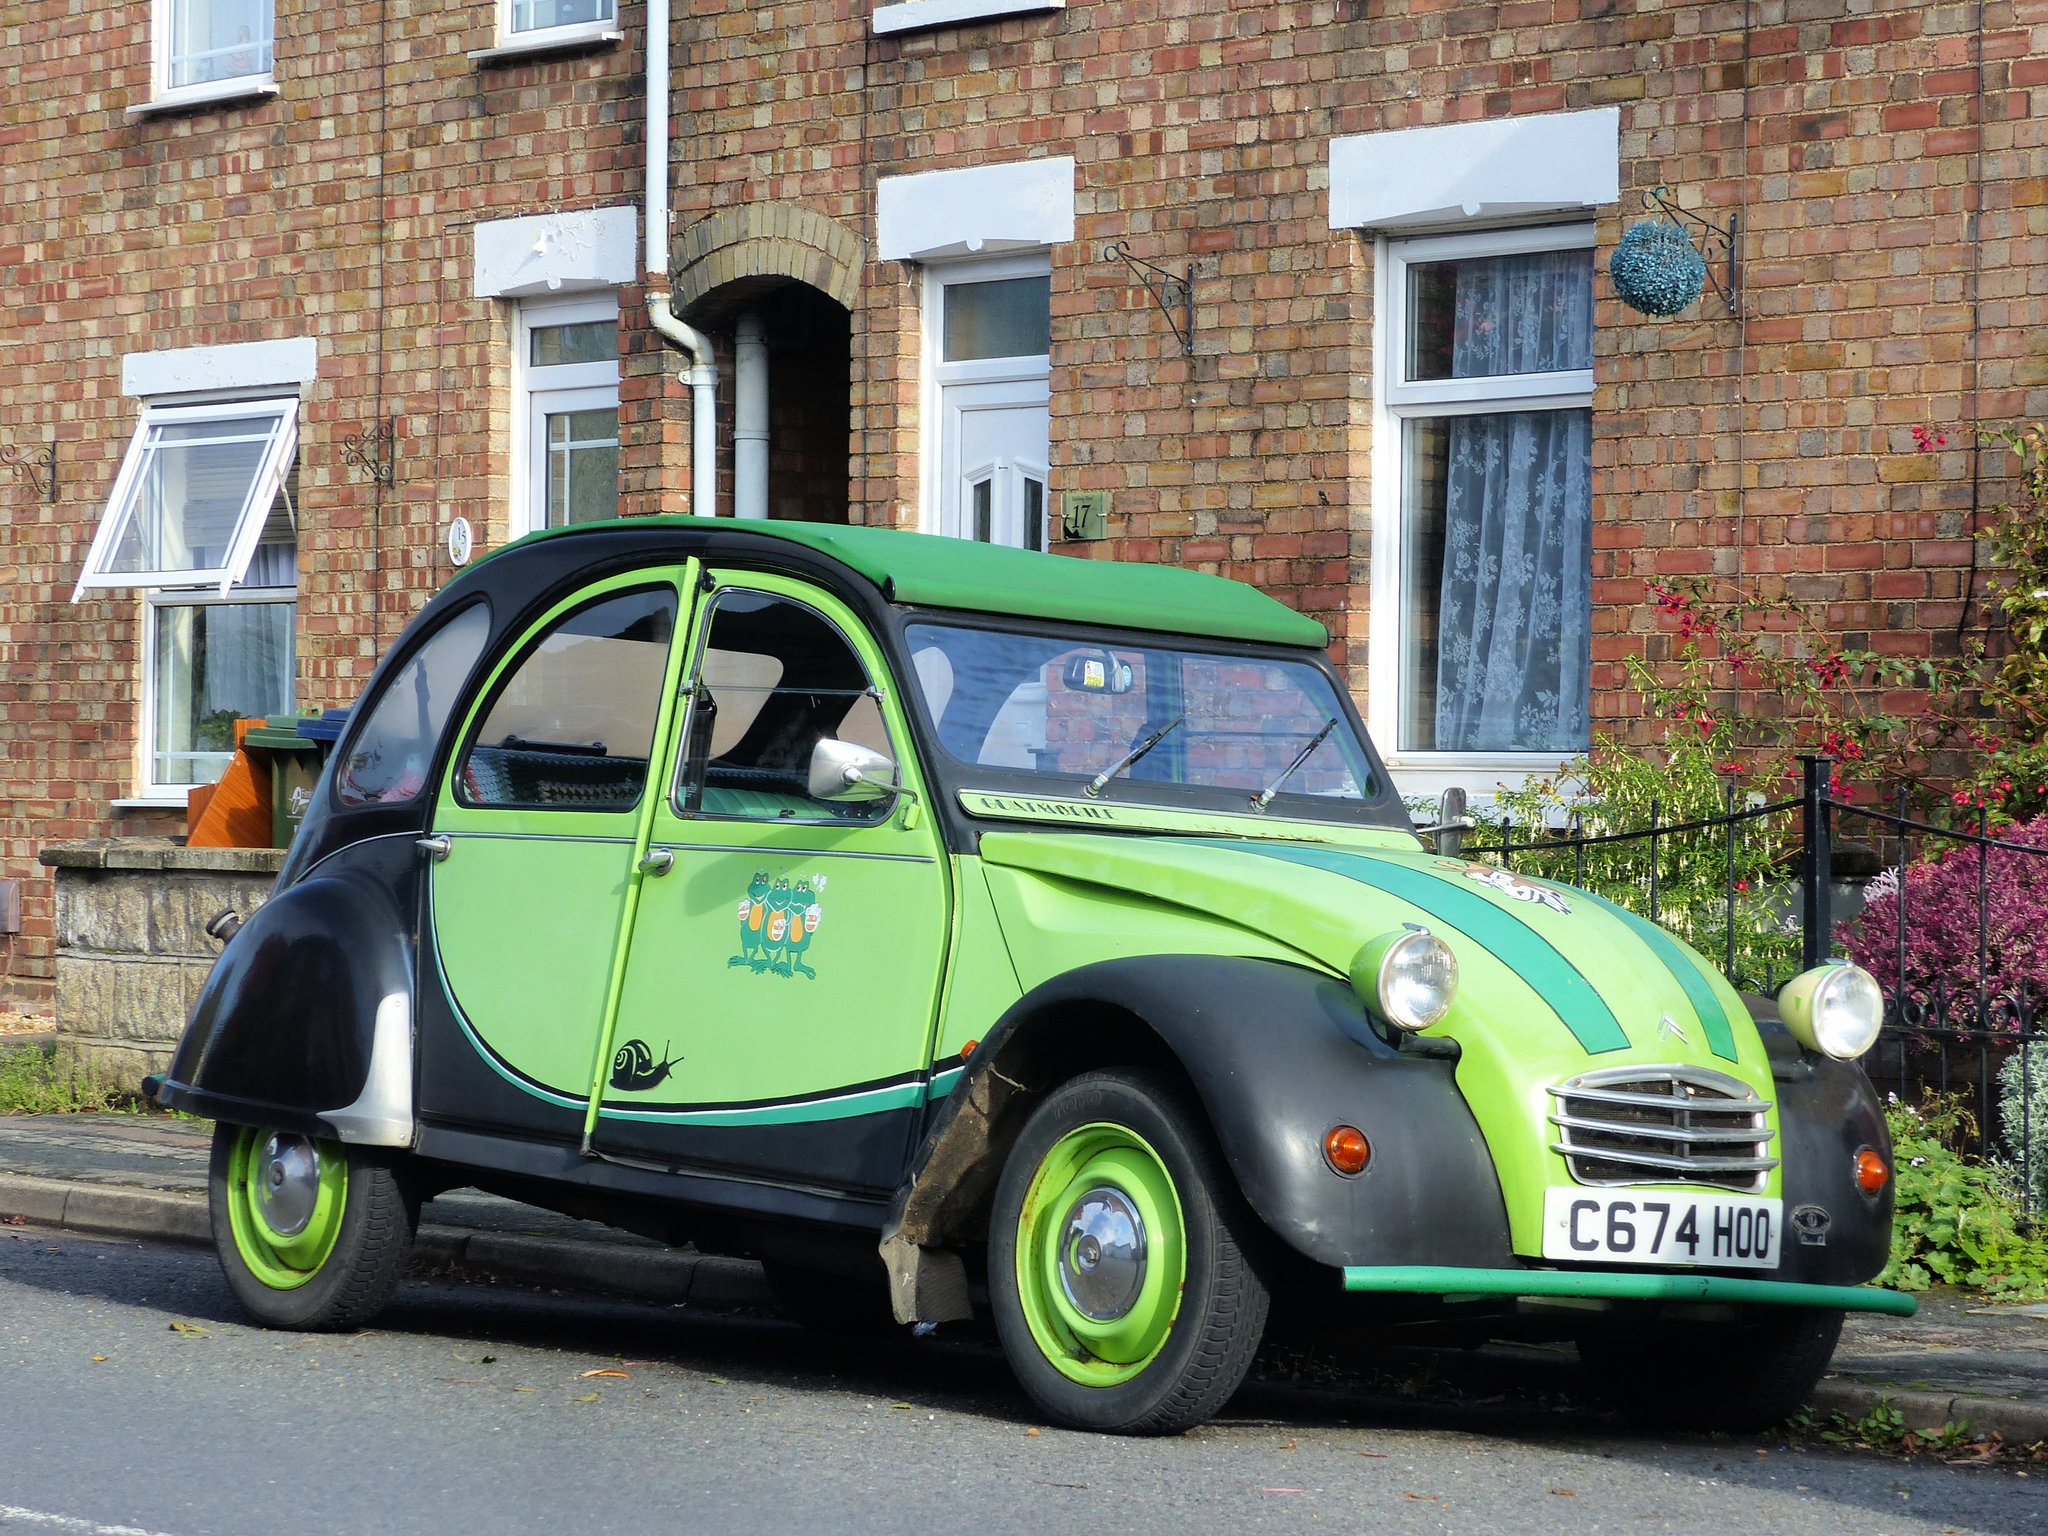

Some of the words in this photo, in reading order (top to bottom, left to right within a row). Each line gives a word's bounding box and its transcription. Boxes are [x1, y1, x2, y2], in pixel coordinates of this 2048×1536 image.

[1072, 505, 1091, 528] 17
[458, 527, 466, 544] 15
[1569, 1199, 1700, 1257] C674
[1713, 1205, 1770, 1260] HOO
